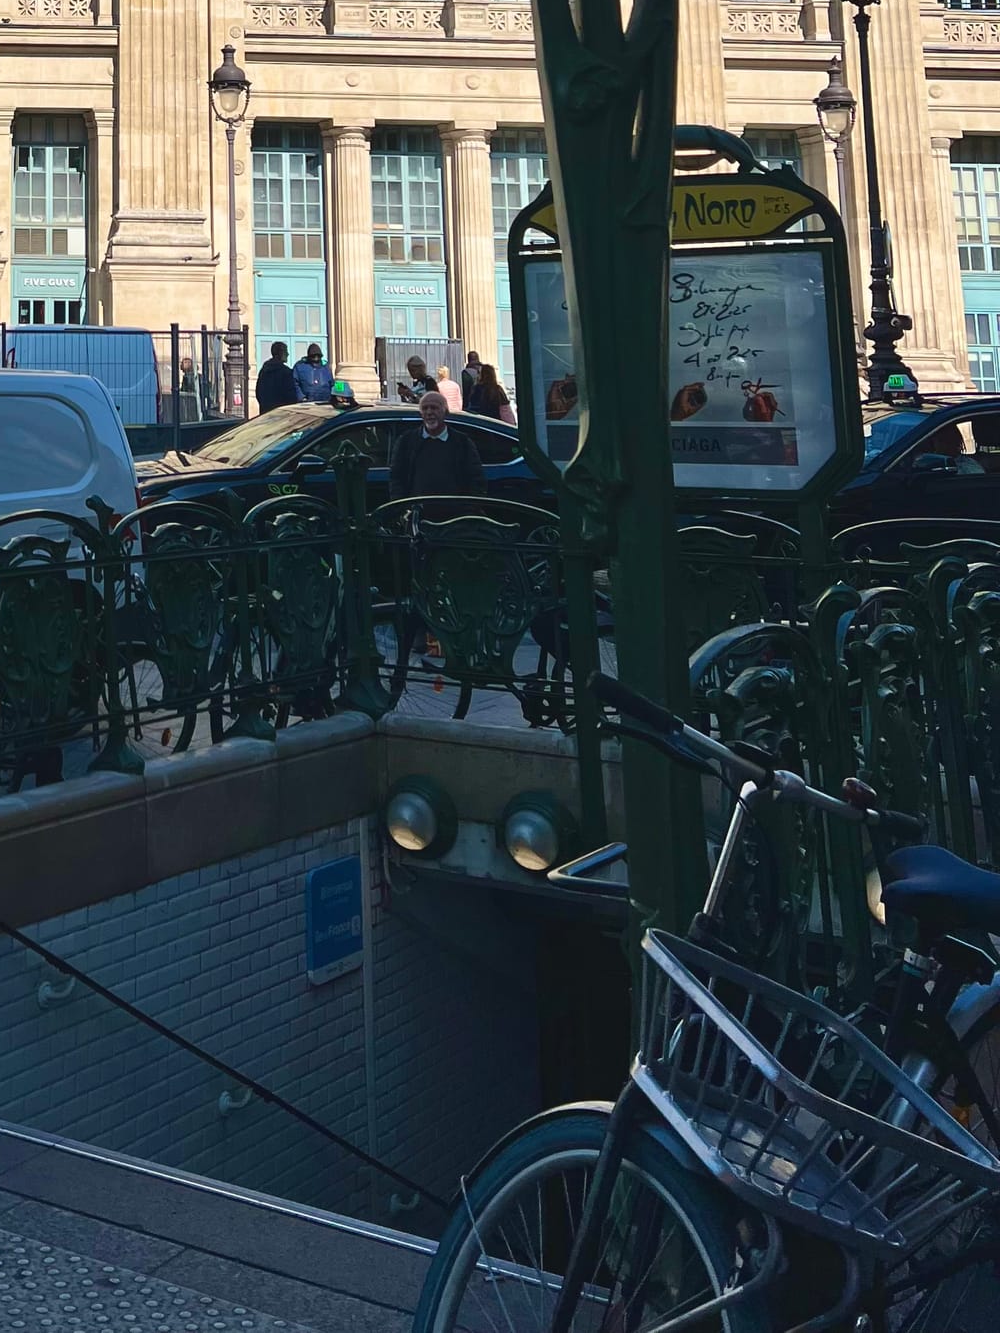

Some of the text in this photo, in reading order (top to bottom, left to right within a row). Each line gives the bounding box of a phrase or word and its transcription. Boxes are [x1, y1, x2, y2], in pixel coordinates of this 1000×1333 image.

[23, 278, 76, 287] FIVE GUYS
[384, 285, 436, 295] FIVE GUYS
[282, 484, 299, 494] G7
